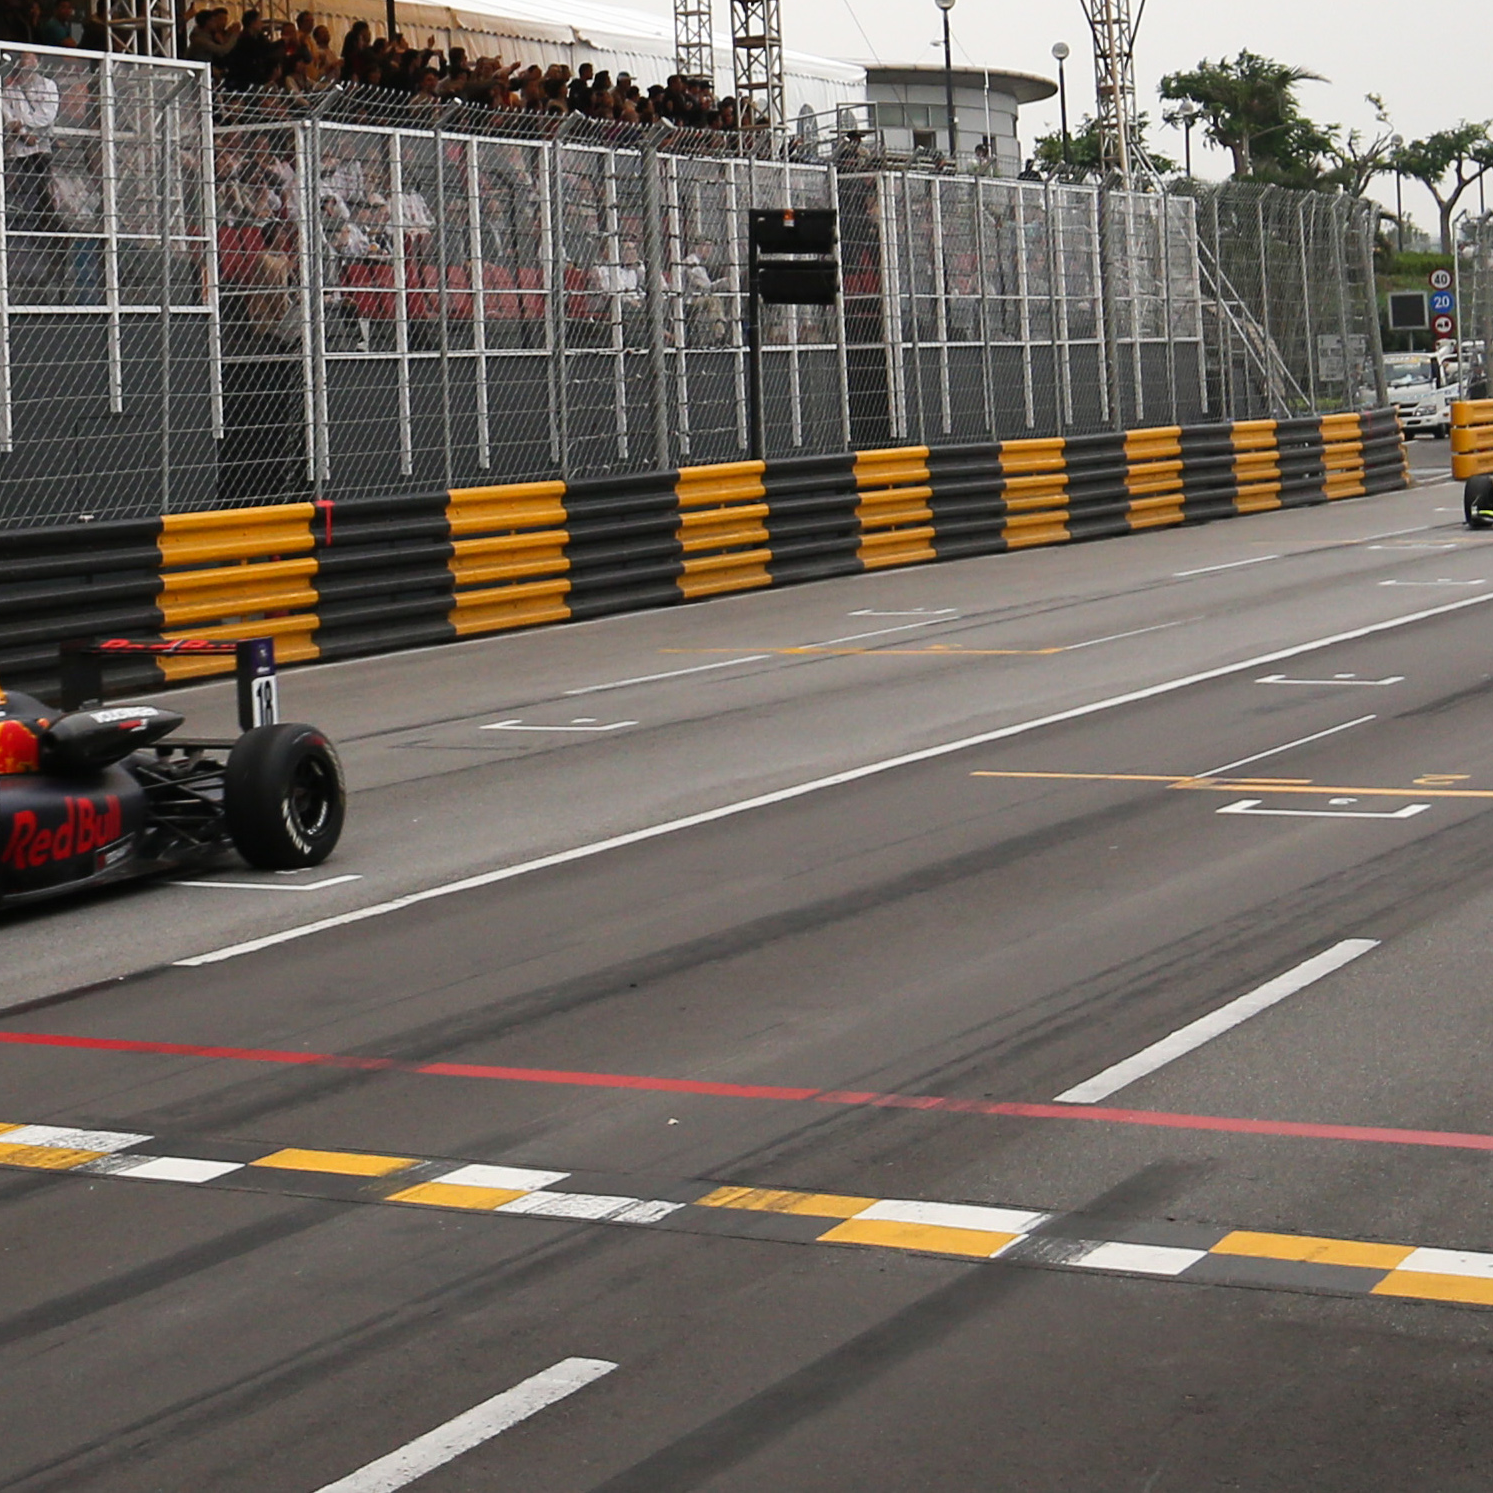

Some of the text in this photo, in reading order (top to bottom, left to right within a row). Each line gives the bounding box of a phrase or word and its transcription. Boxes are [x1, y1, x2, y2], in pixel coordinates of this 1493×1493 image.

[1434, 274, 1448, 285] 40
[1433, 295, 1450, 309] 20
[256, 680, 273, 725] 18
[0, 795, 76, 870] Red
[75, 794, 122, 854] Bull
